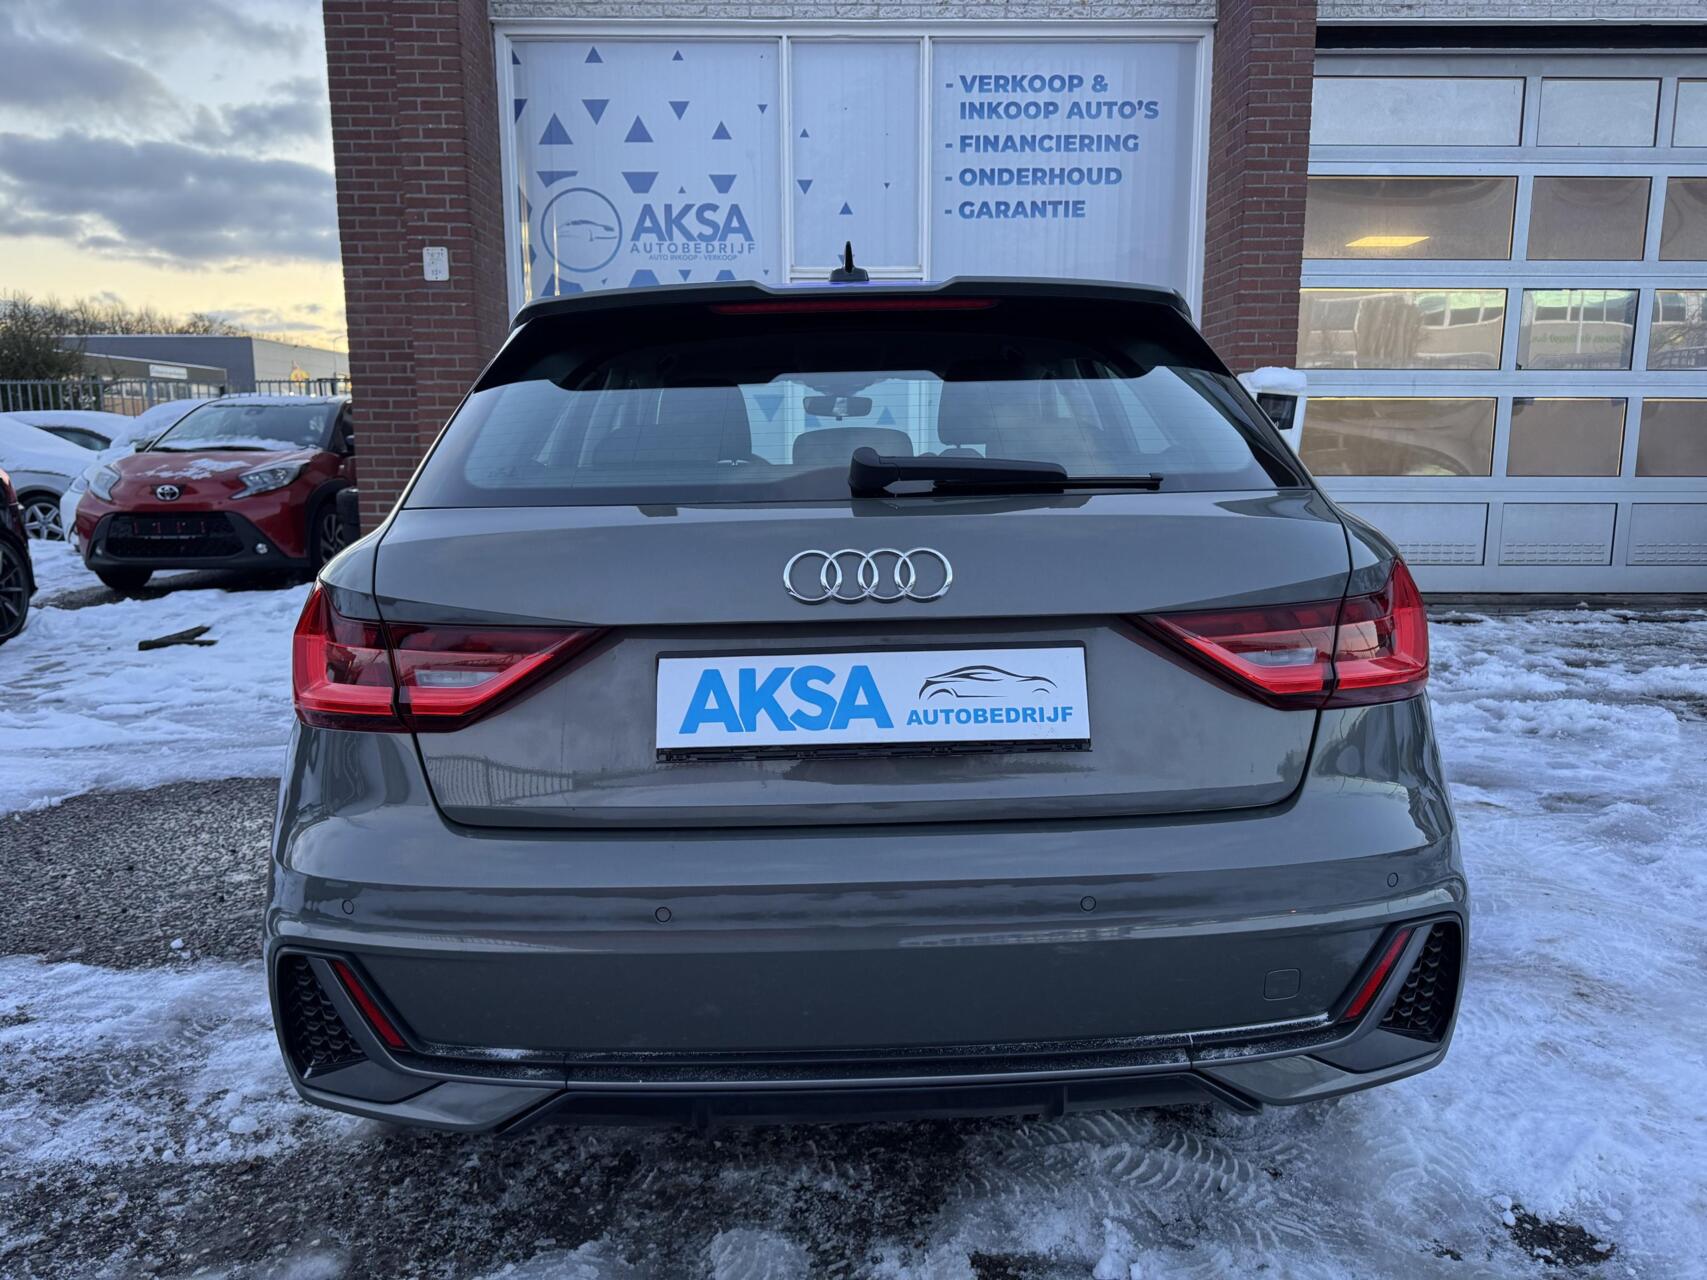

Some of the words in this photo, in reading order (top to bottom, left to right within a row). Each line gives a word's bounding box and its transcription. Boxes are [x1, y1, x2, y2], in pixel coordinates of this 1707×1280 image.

[959, 74, 1084, 93] VERKOOP
[1091, 74, 1109, 93] &
[959, 101, 1060, 120] INKOOP
[959, 134, 1140, 153] FINANCIERING
[958, 167, 1122, 186] ONDERHOUD
[958, 200, 1086, 220] GARANTIE
[631, 203, 754, 242] AKSA
[631, 243, 756, 254] AUTOBEDRIJF
[678, 665, 894, 734] AKSA
[906, 706, 1074, 725] AUTOBEDRIJF
